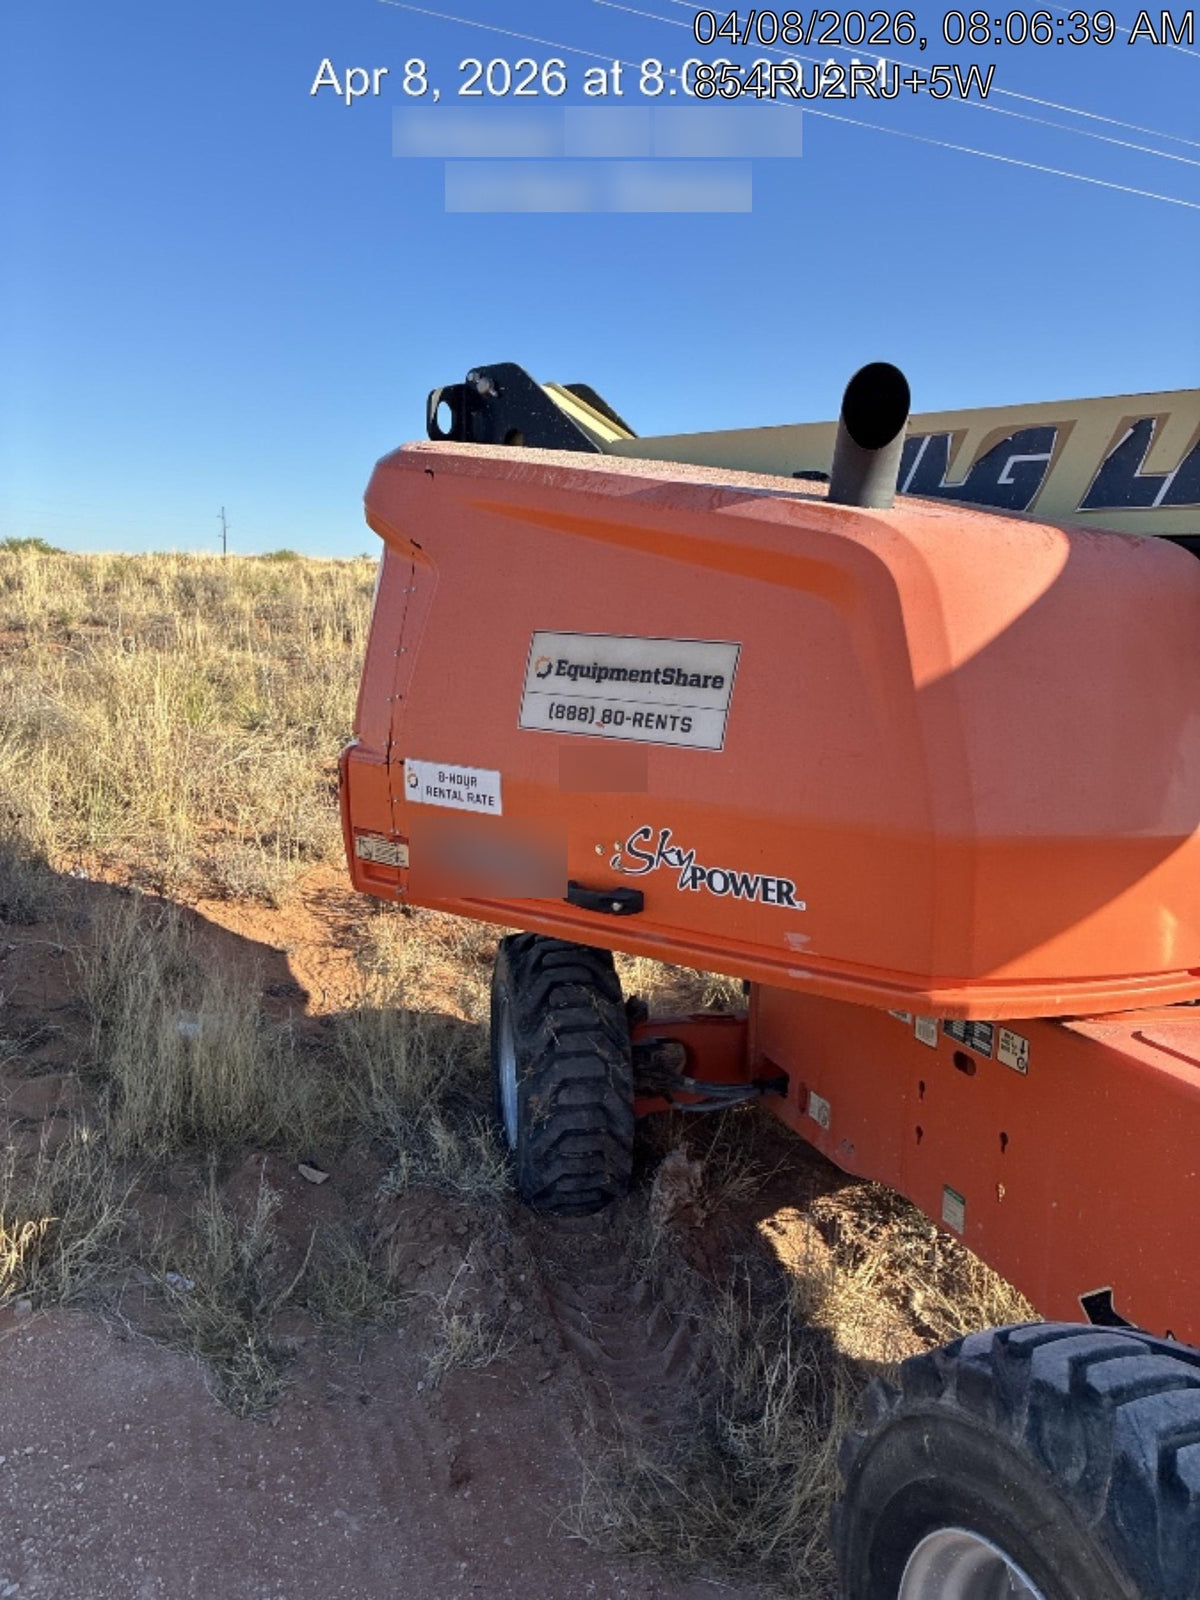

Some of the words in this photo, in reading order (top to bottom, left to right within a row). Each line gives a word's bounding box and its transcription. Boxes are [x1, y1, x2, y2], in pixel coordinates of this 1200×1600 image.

[897, 425, 1058, 512] LG
[555, 659, 724, 690] EquipmentShare
[548, 702, 595, 724] (888)
[600, 708, 693, 733] 80-RENTS
[426, 785, 464, 802] RENTAL
[467, 793, 495, 806] RATE
[438, 771, 477, 789] 8-HOUR
[610, 826, 695, 890] Sky
[690, 864, 798, 909] POWER
